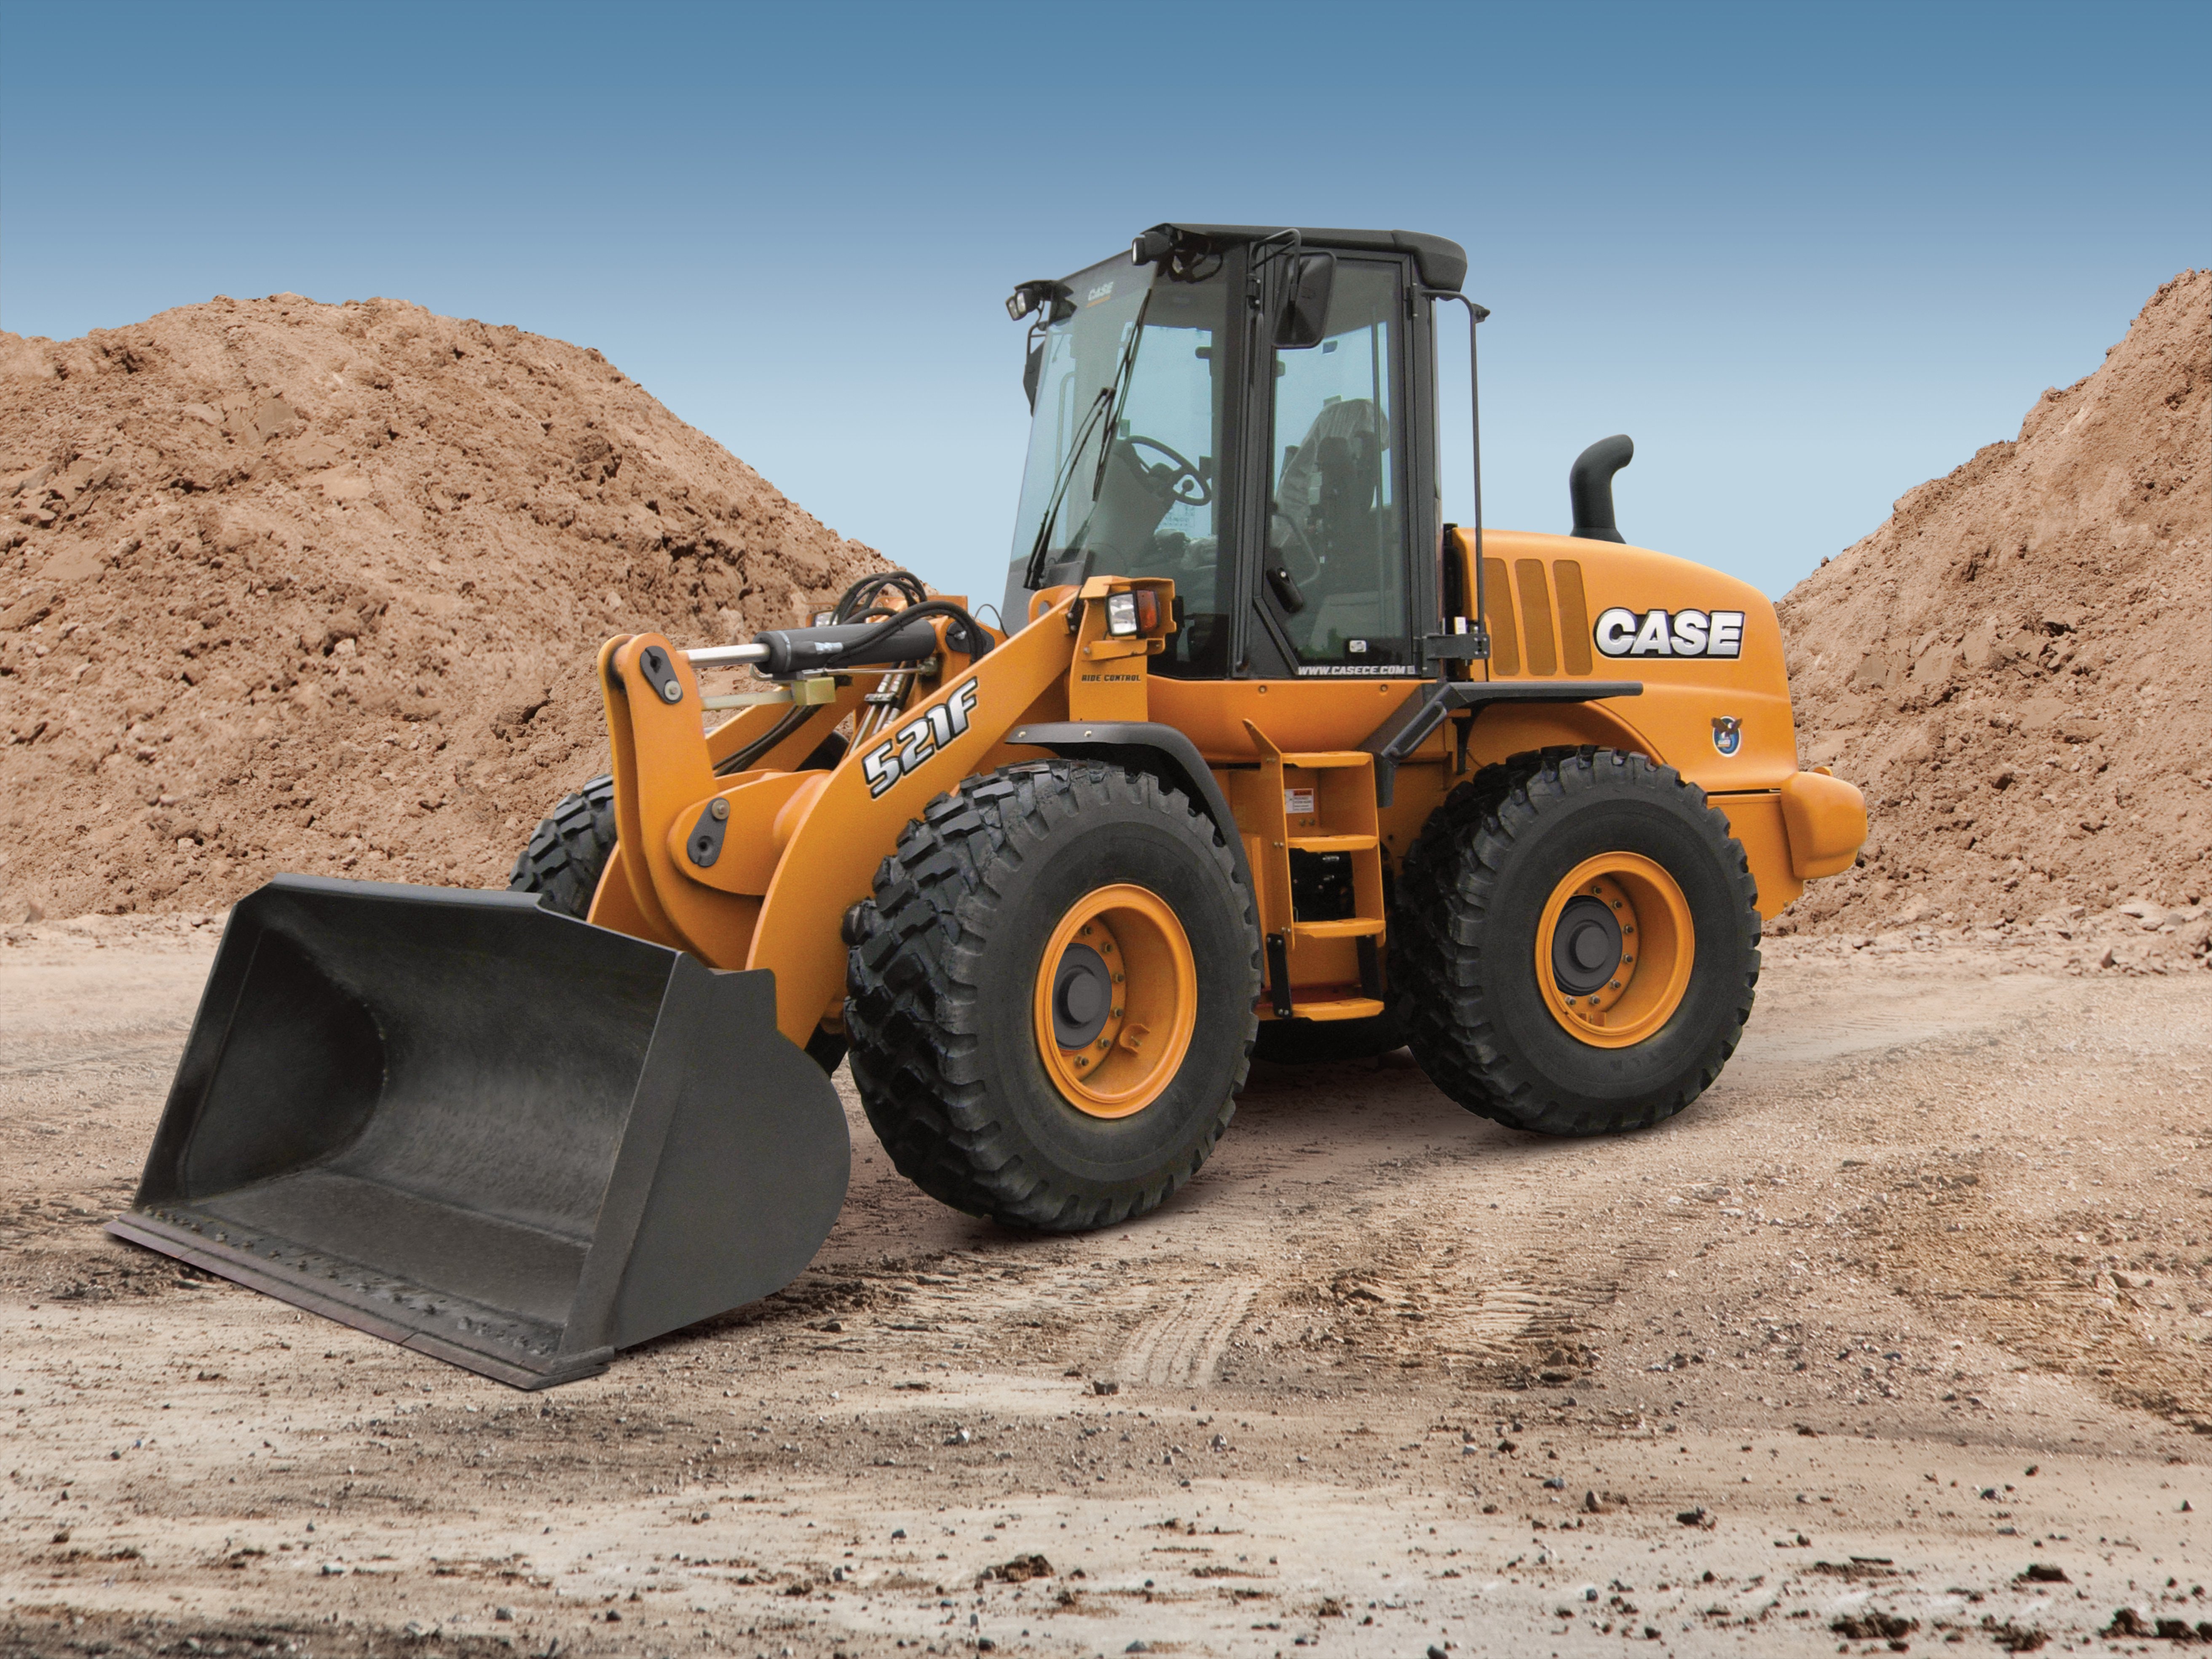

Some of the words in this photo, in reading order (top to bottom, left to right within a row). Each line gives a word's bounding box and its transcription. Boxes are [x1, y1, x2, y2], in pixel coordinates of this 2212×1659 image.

[1088, 281, 1114, 301] CASE
[1594, 607, 1743, 656] CASE
[1298, 665, 1406, 675] WWW.CASECE.COM
[862, 676, 978, 799] 521F
